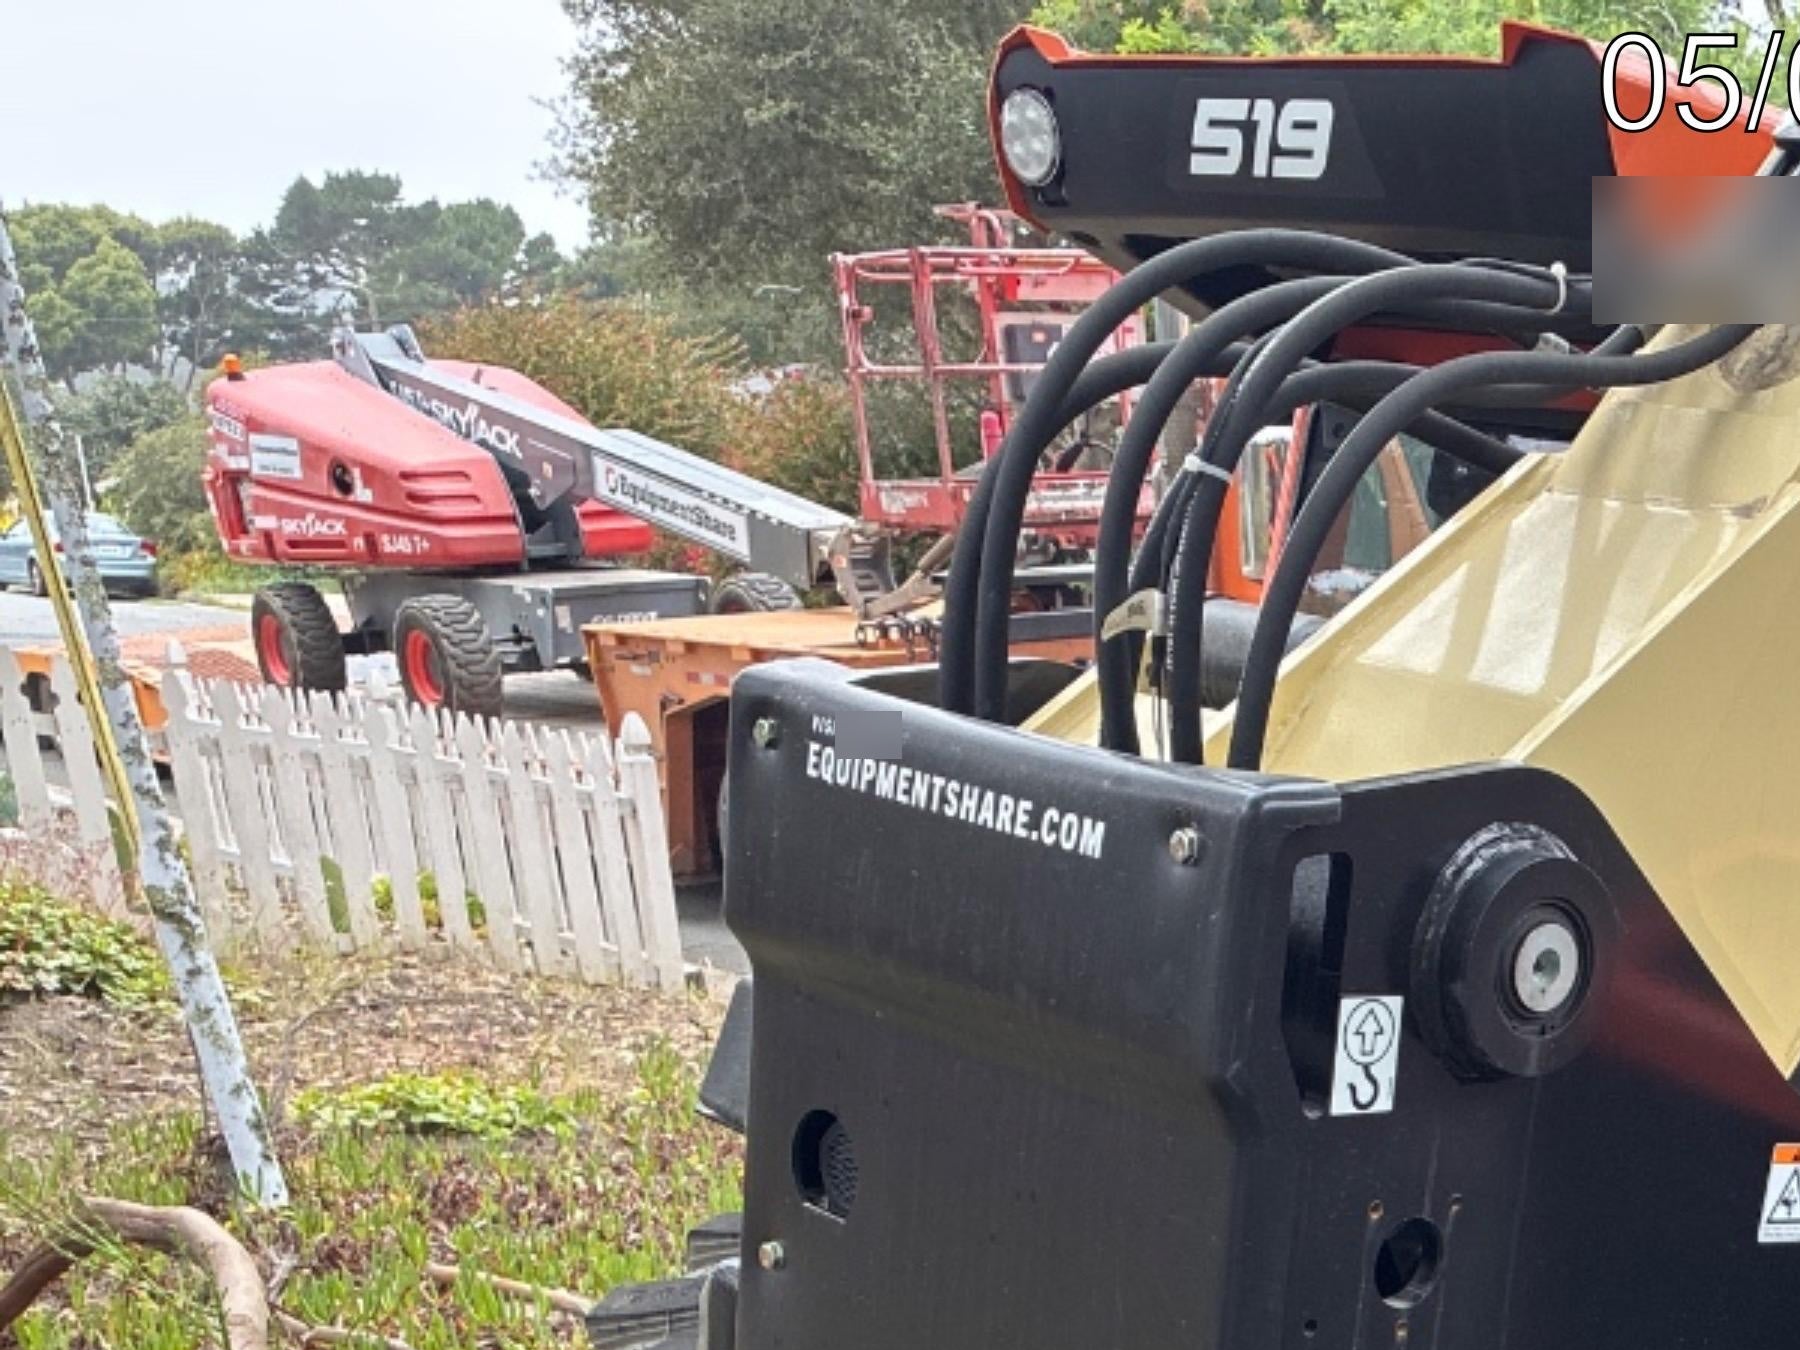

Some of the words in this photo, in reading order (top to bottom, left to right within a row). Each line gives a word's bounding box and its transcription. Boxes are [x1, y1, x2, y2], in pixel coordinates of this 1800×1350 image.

[1190, 98, 1334, 180] 519
[281, 512, 348, 538] SKYJACK
[806, 741, 1106, 860] EQUIPMENTSHARE.COM
